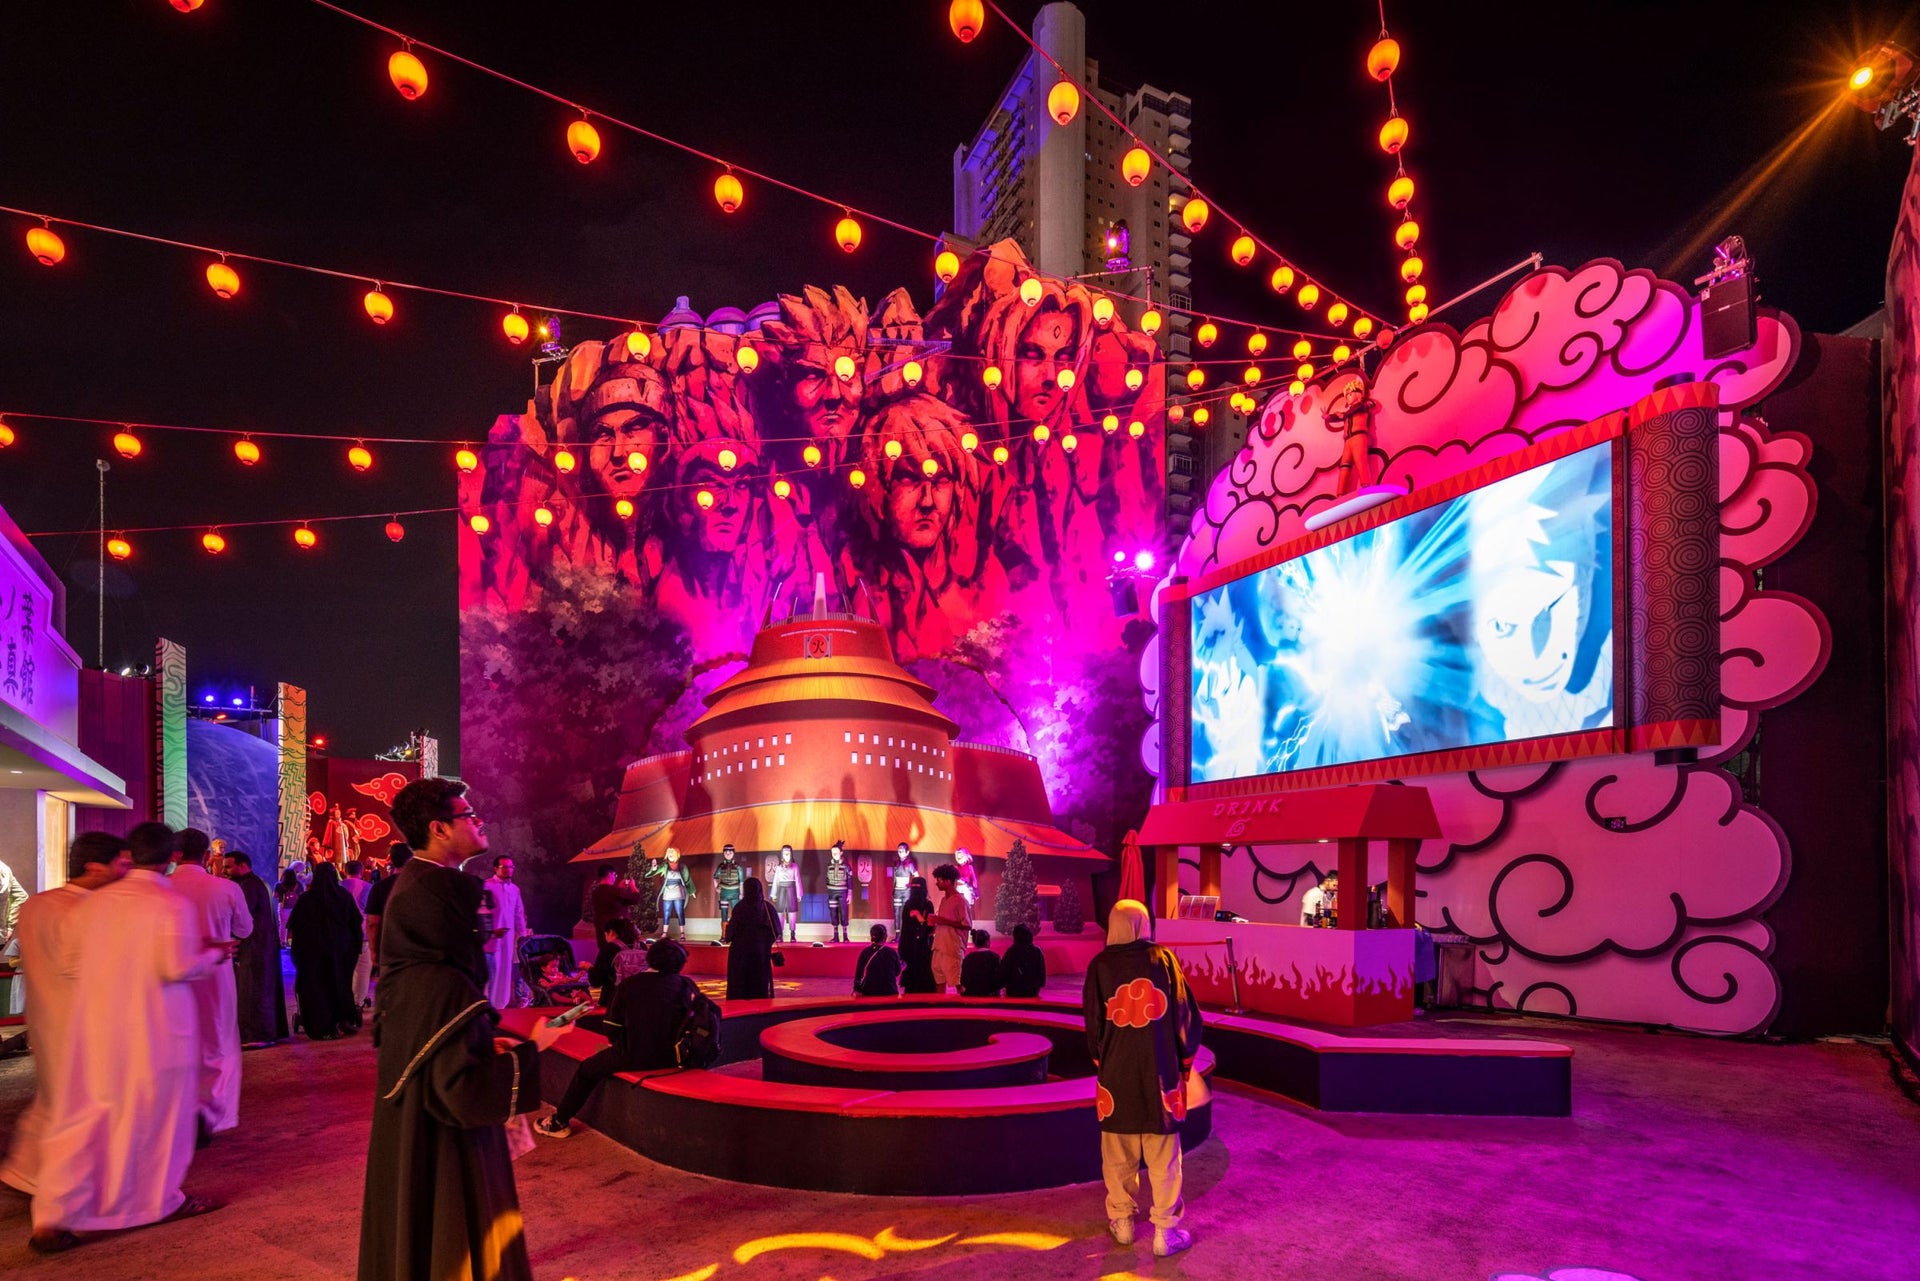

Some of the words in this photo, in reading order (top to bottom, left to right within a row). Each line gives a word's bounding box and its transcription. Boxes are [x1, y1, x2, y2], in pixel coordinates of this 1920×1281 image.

[0, 584, 35, 646] ノ葉
[812, 639, 825, 654] 火
[1213, 798, 1284, 817] DRINK
[859, 862, 870, 873] 火
